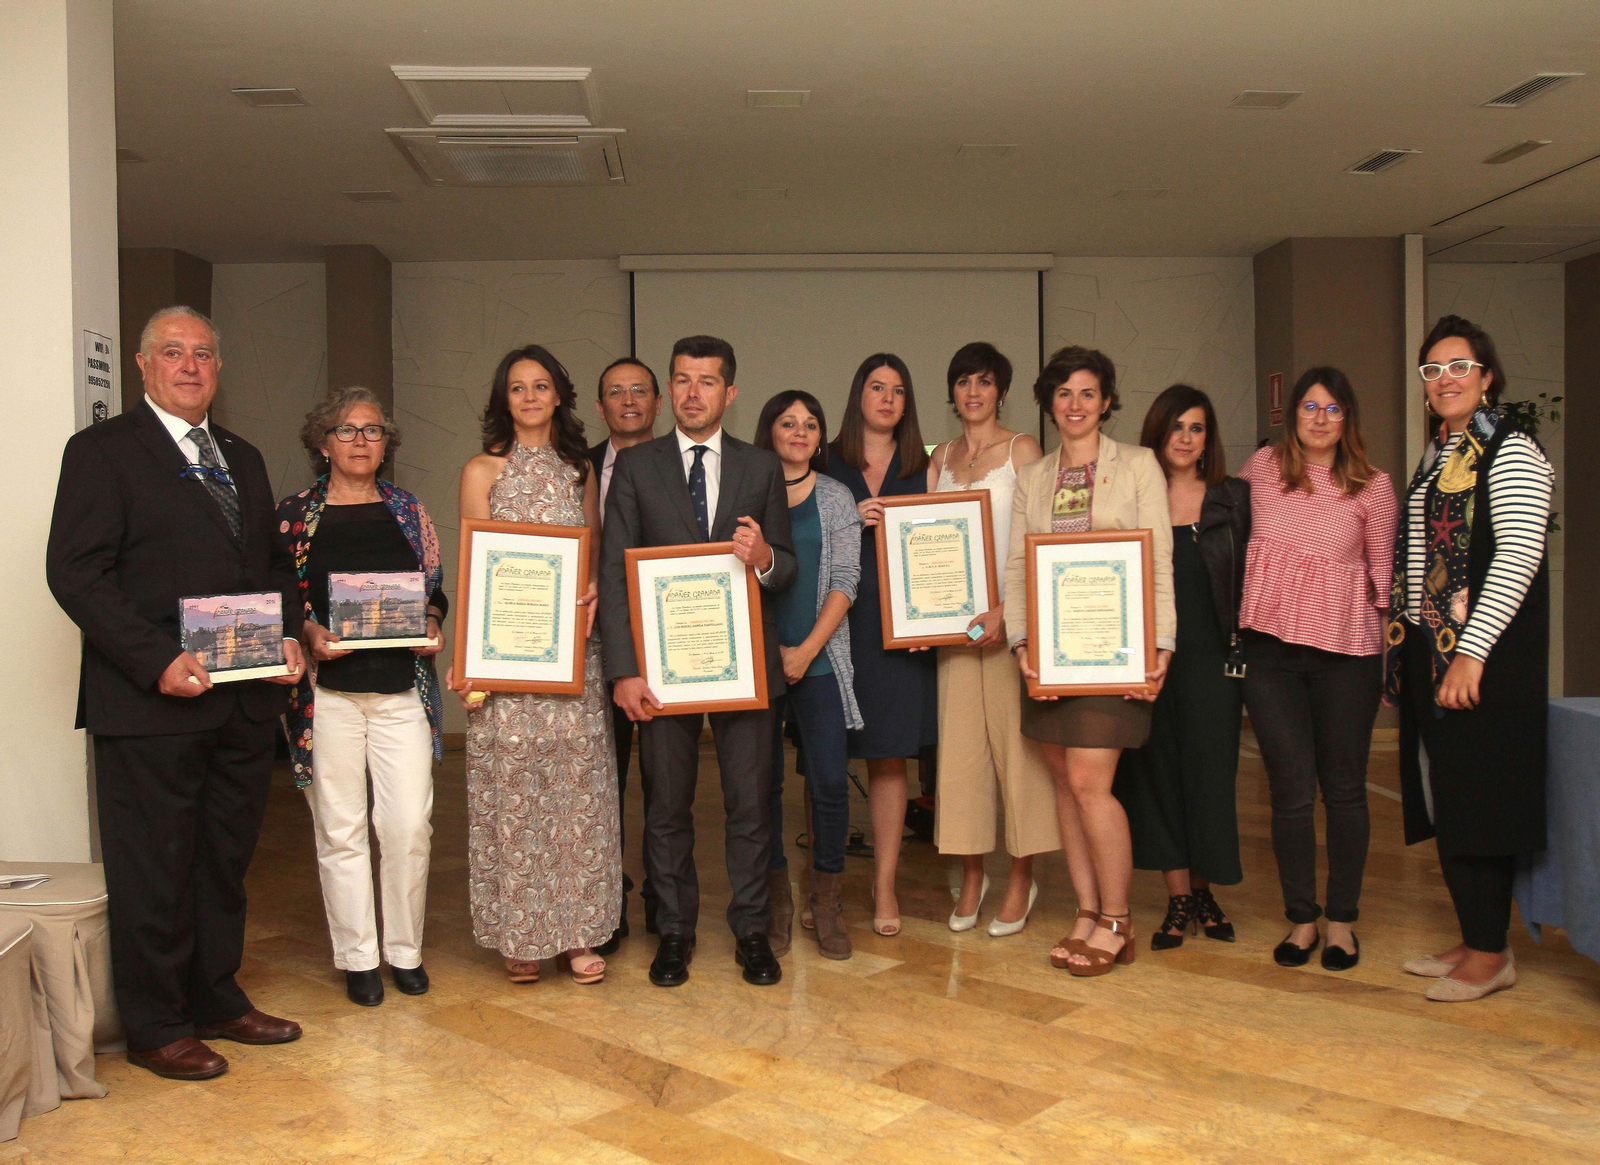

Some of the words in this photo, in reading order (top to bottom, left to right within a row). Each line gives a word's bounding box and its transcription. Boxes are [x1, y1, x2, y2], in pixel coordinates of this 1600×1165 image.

[934, 533, 959, 542] GRANADA
[523, 569, 551, 577] GRANADA
[692, 589, 720, 599] GRANADA
